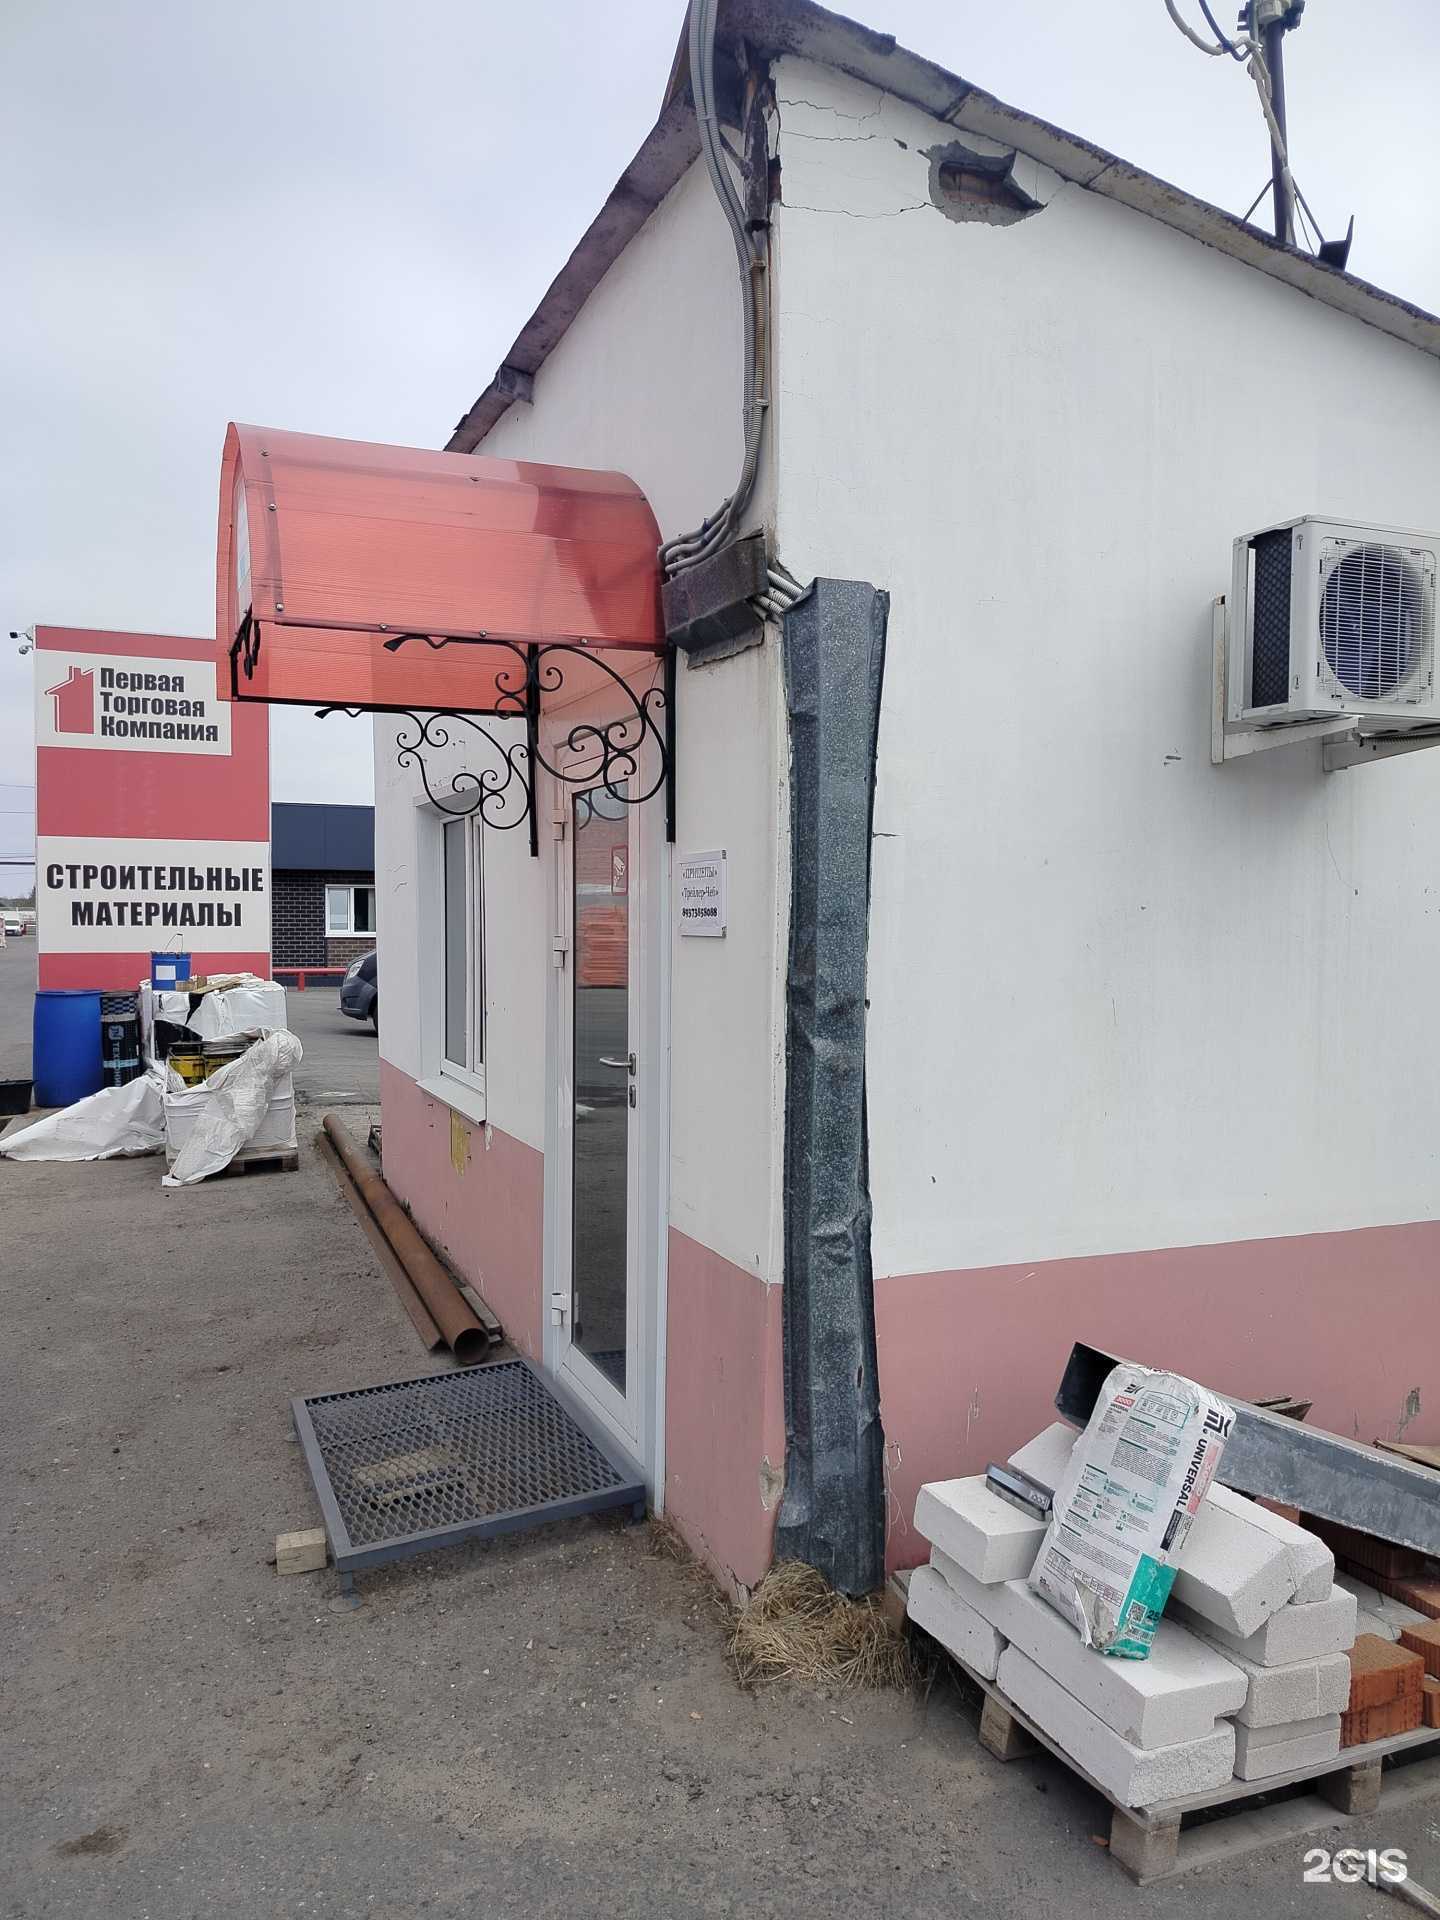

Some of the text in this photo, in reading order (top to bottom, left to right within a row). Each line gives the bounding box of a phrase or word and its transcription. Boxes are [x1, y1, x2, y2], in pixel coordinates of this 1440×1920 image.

[100, 667, 185, 693] Первая
[100, 692, 205, 718] Торговая
[101, 716, 218, 742] Компания
[46, 863, 264, 892] СТРОИТЕЛЬНЫЕ
[71, 901, 242, 927] МАТЕРИАЛЫ
[1176, 1438, 1208, 1510] UNIVERSAL
